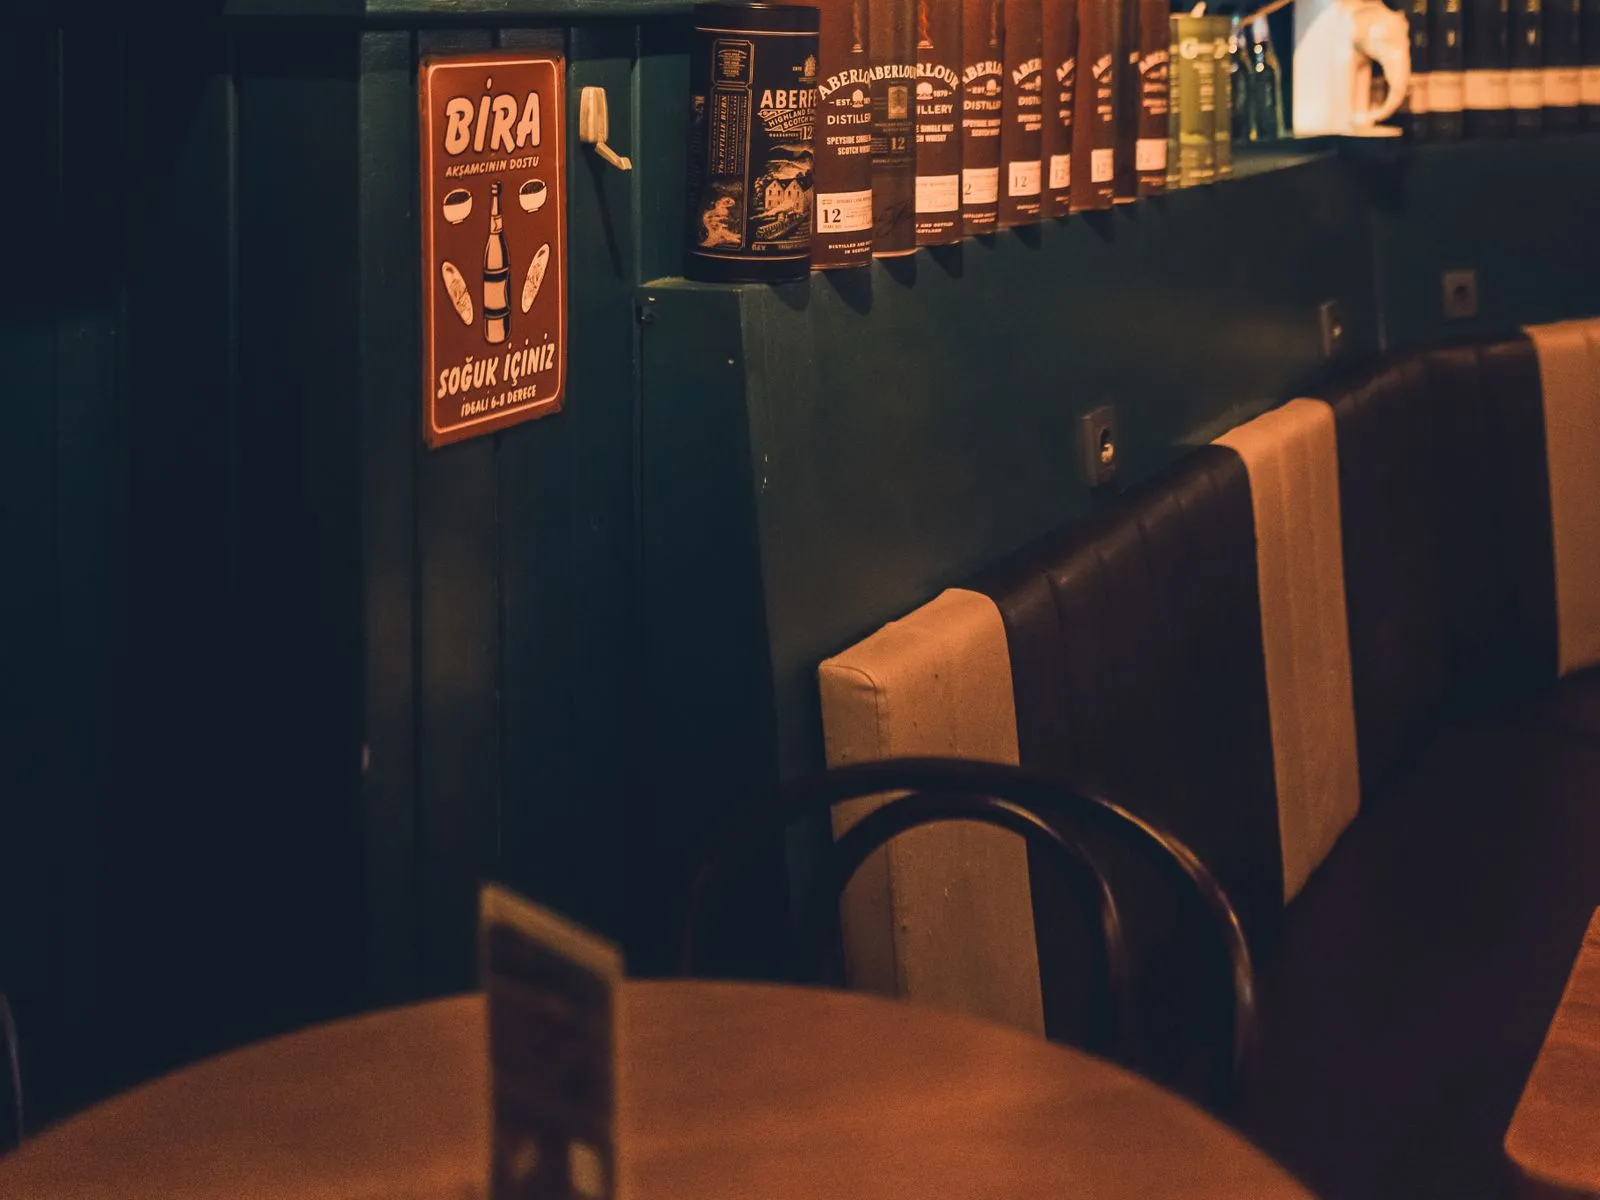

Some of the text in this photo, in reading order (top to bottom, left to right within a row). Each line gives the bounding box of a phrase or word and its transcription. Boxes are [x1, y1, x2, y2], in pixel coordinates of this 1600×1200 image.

[916, 63, 959, 91] RLOUR
[818, 68, 870, 101] ABERLO
[444, 77, 541, 155] BİRA
[917, 105, 953, 115] ILLERY
[768, 109, 806, 128] HIGHLAND
[783, 115, 809, 129] SCOTCH
[827, 112, 871, 125] DISTILLE
[826, 135, 856, 145] SPEYSIDE
[891, 137, 905, 151] 12
[837, 145, 859, 156] SCOTCH
[509, 156, 540, 171] DOSTU
[1014, 175, 1028, 188] 12
[963, 183, 972, 196] 2
[823, 208, 842, 224] 12
[437, 333, 555, 400] SOĞUK İÇİNİZ
[507, 384, 537, 404] DERECE
